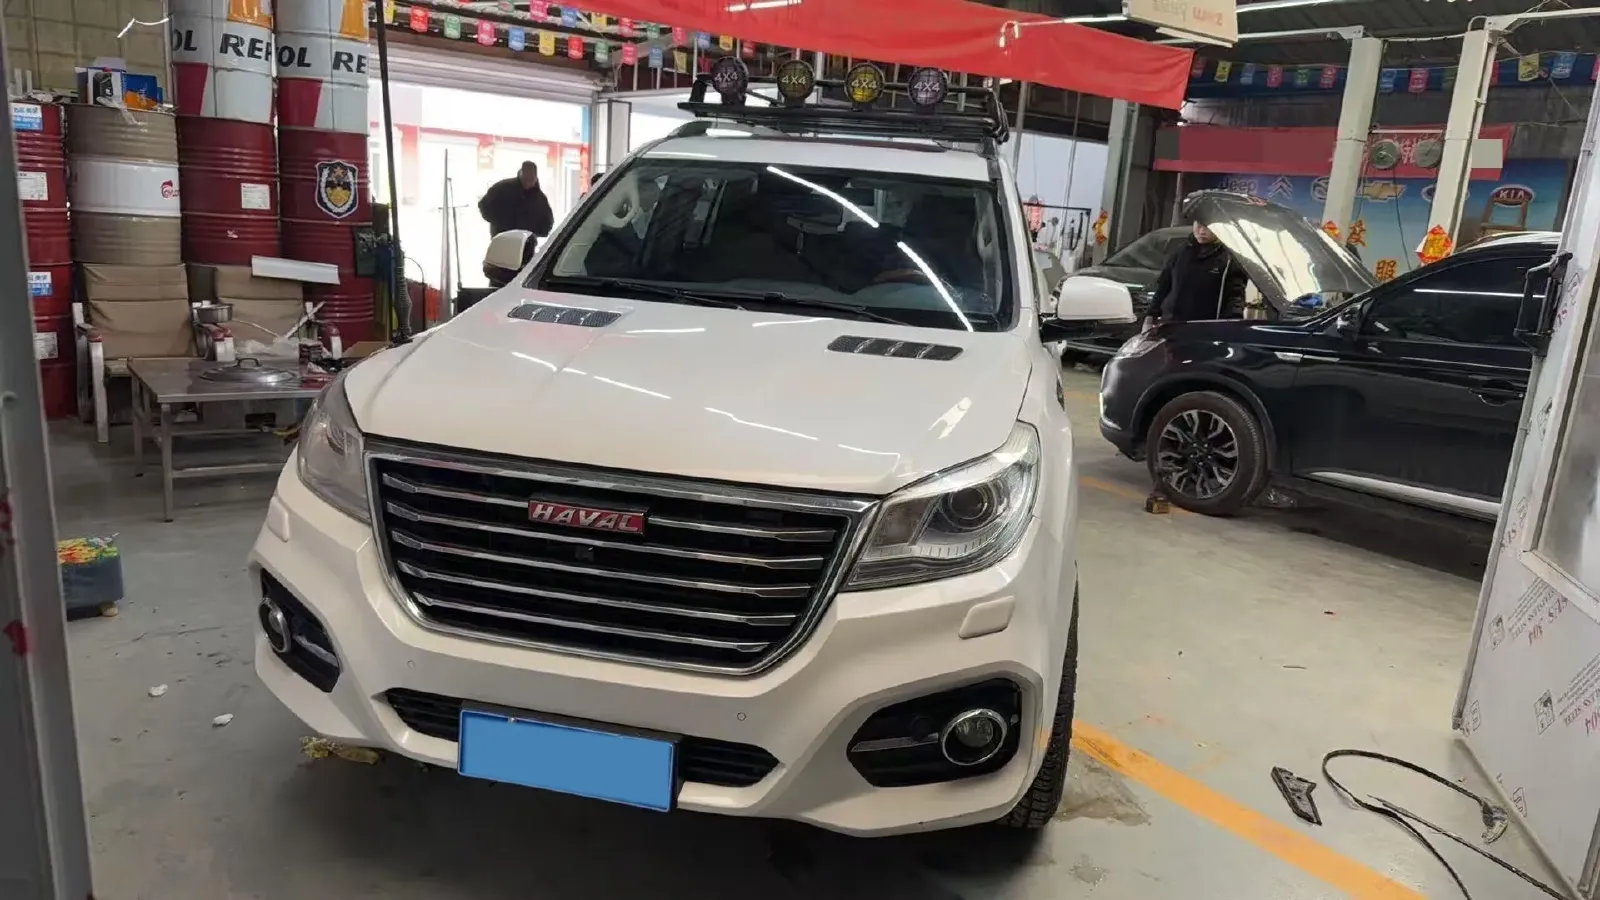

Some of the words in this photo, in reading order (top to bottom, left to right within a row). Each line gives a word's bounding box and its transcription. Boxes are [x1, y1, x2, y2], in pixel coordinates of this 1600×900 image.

[276, 46, 312, 68] OL
[714, 71, 739, 83] 4X4
[781, 74, 806, 86] 4X4
[851, 78, 877, 90] 4X4
[914, 80, 941, 93] 4X4
[1219, 176, 1258, 196] Jeep
[1500, 189, 1525, 199] KIA
[532, 503, 639, 532] HAVAL
